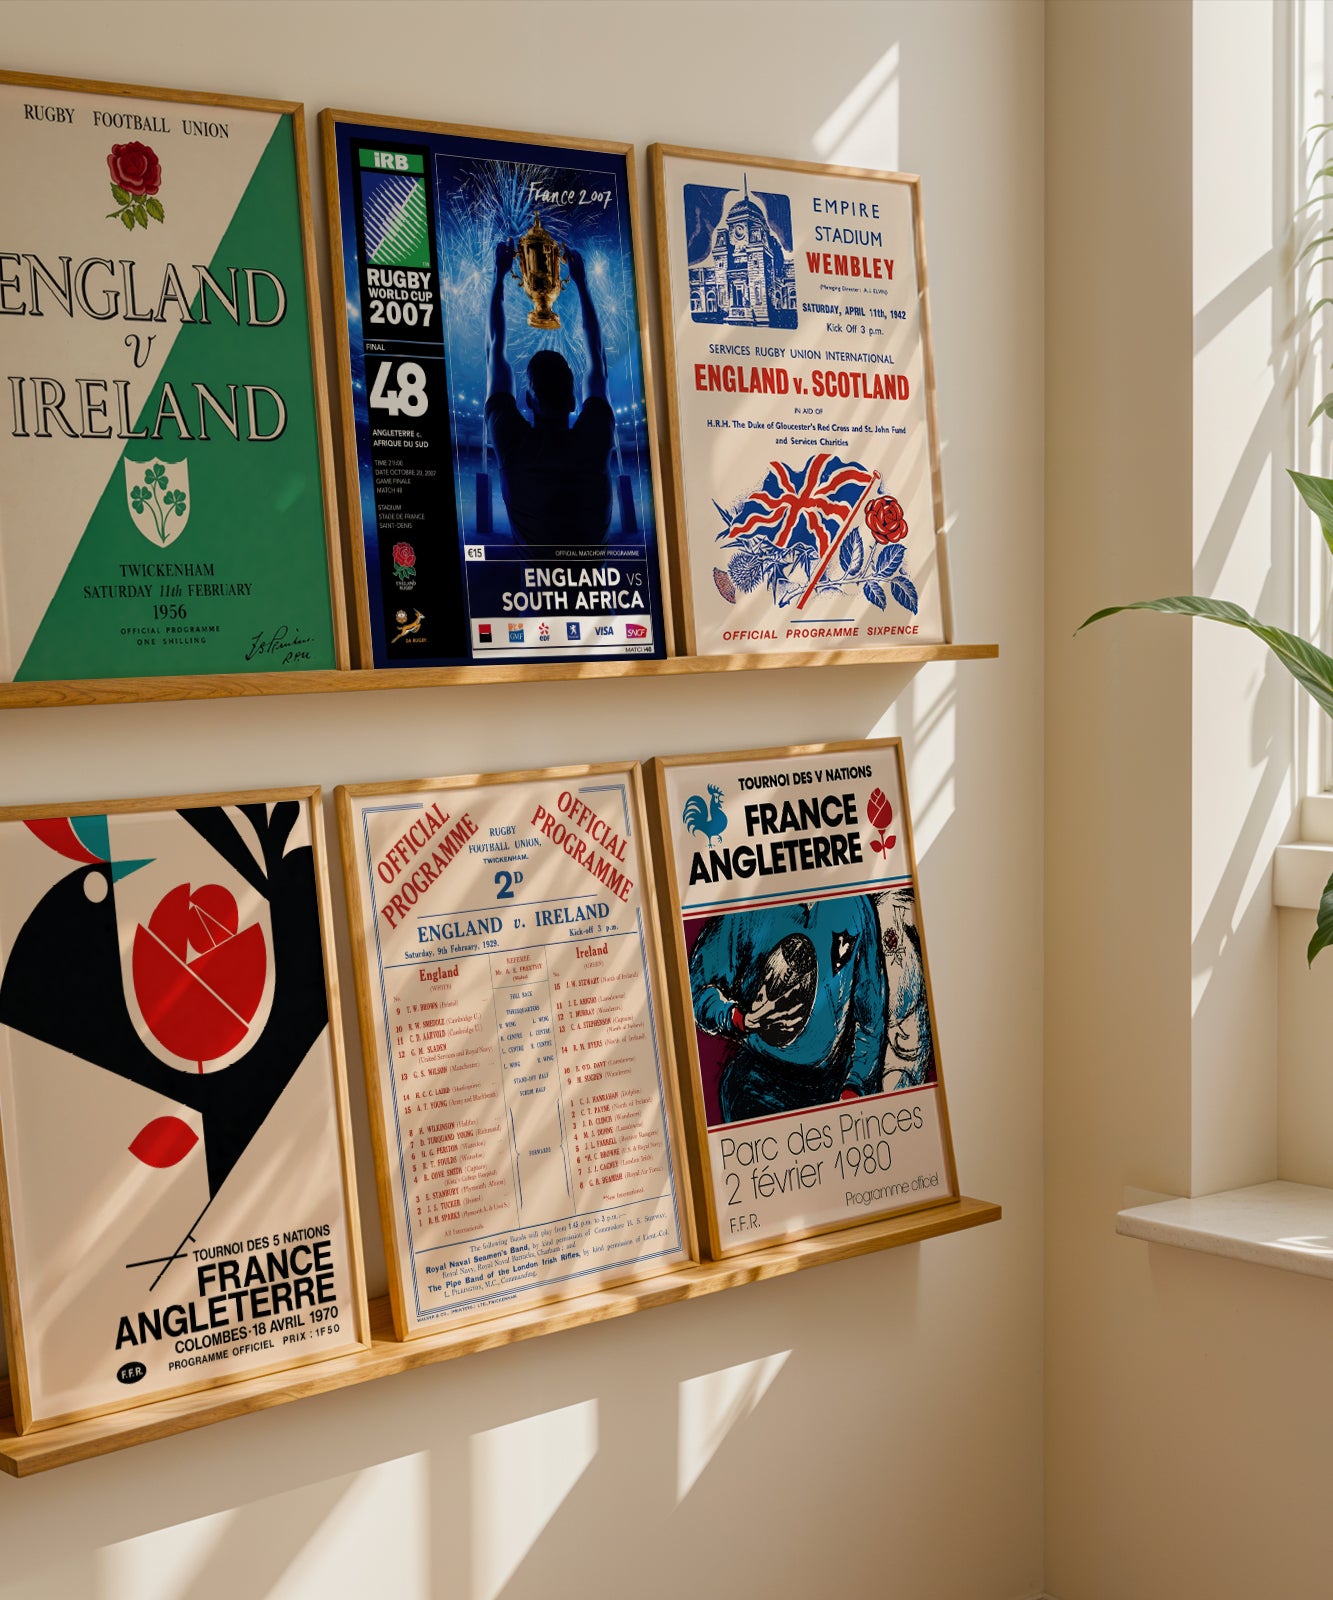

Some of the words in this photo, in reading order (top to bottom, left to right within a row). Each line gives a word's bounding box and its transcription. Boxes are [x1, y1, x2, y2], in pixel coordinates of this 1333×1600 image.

[24, 104, 75, 123] RUGBY
[94, 111, 170, 133] FOOTBALL
[182, 120, 229, 138] UNION
[527, 181, 574, 204] France
[579, 190, 612, 209] 2007
[813, 198, 879, 219] EMPIRE
[815, 226, 882, 247] STADIUM
[806, 251, 894, 280] WEMBLEY
[0, 253, 287, 326] ENGLAND
[367, 268, 431, 290] RUGBY
[368, 287, 408, 301] WORLD
[410, 291, 432, 302] CUP
[369, 300, 433, 327] 2007
[802, 303, 841, 316] SATURDAY,
[845, 306, 865, 317] APRIL
[870, 309, 887, 319] 11th,
[890, 310, 906, 319] 1942
[827, 323, 842, 332] Kick
[846, 325, 857, 333] Off
[869, 327, 884, 336] p.m.
[366, 343, 385, 351] FINAL
[709, 344, 750, 355] SERVICES
[755, 347, 785, 357] RUGBY
[790, 349, 821, 359] UNION
[826, 351, 894, 364] INTERNATIONAL
[370, 361, 428, 417] 48
[694, 364, 789, 394] ENGLAND
[793, 378, 808, 395] v.
[811, 370, 909, 400] SCOTLAND
[8, 376, 287, 441] IRELAND
[372, 429, 415, 437] ANGLETERRE
[707, 420, 730, 428] H.R.H.
[732, 420, 745, 429] The
[748, 421, 765, 430] Duke
[767, 421, 774, 429] of
[776, 422, 816, 431] Gloucester's
[818, 423, 830, 431] Red
[832, 424, 849, 432] Cross
[851, 424, 862, 432] and
[865, 425, 873, 433] St.
[875, 425, 889, 433] John
[892, 426, 906, 434] Fund
[373, 439, 402, 447] AFRIQUE
[791, 437, 817, 446] Services
[820, 438, 848, 446] Charities
[468, 549, 482, 558] €15
[120, 563, 214, 577] TWICKENHAM
[524, 568, 621, 588] ENGLAND
[626, 573, 642, 586] VS
[84, 585, 152, 599] SATURDAY
[160, 585, 182, 597] 11th
[188, 583, 252, 597] FEBRUARY
[502, 592, 568, 611] SOUTH
[575, 591, 644, 610] AFRICA
[153, 604, 187, 620] 1956
[121, 627, 160, 635] OFFICIAL
[166, 625, 220, 633] PROGRAMME
[594, 626, 614, 636] VISA
[628, 629, 646, 637] SNCF
[723, 629, 778, 641] OFFICIAL
[786, 627, 858, 638] PROGRAMME
[867, 626, 918, 636] SIXPENCE
[137, 638, 156, 646] ONE
[163, 637, 206, 645] SHILLING
[738, 774, 789, 790] TOURNOI
[794, 771, 812, 785] DES
[815, 770, 822, 782] V
[826, 765, 872, 782] NATIONS
[745, 793, 858, 836] FRANCE
[489, 825, 516, 837] RUGBY
[557, 791, 628, 863] OFFICIAL
[377, 803, 450, 884] OFFICIAL
[469, 842, 510, 854] FOOTBALL
[530, 804, 634, 903] PROGRAMME
[689, 832, 863, 885] ANGLETERRE
[381, 813, 479, 930] PROGRAMME
[417, 916, 503, 943] ENGLAND
[513, 918, 525, 929] v.
[535, 902, 610, 927] IRELAND
[569, 927, 593, 937] Kick-off
[405, 949, 434, 960] Saturday,
[437, 947, 448, 955] 9th
[450, 943, 480, 954] February,
[576, 943, 608, 958] Ireland
[419, 964, 459, 982] England
[721, 1136, 778, 1170] Parc
[787, 1124, 833, 1155] des
[839, 1106, 923, 1144] Princes
[726, 1173, 742, 1205] 2
[751, 1160, 823, 1199] février
[834, 1140, 892, 1179] 1980
[846, 1182, 909, 1206] Programme
[911, 1172, 939, 1192] officiel
[730, 1214, 761, 1233] F.F.R.
[193, 1242, 243, 1262] TOURNOI
[247, 1237, 269, 1252] DES
[273, 1235, 279, 1246] 5
[283, 1224, 330, 1244] NATIONS
[198, 1240, 334, 1297] FRANCE
[426, 1263, 446, 1274] Royal
[450, 1258, 470, 1268] Naval
[474, 1250, 507, 1263] Seamen's
[510, 1244, 529, 1254] Band,
[428, 1285, 441, 1293] The
[446, 1279, 461, 1288] Pipe
[465, 1275, 483, 1283] Band
[513, 1262, 538, 1272] London
[542, 1256, 557, 1265] Irish
[115, 1272, 337, 1350] ANGLETERRE
[270, 1315, 304, 1334] AVRIL
[310, 1306, 338, 1323] 1970
[168, 1350, 229, 1371] PROGRAMME
[233, 1339, 274, 1356] OFFICIEL
[283, 1332, 306, 1345] PRIX
